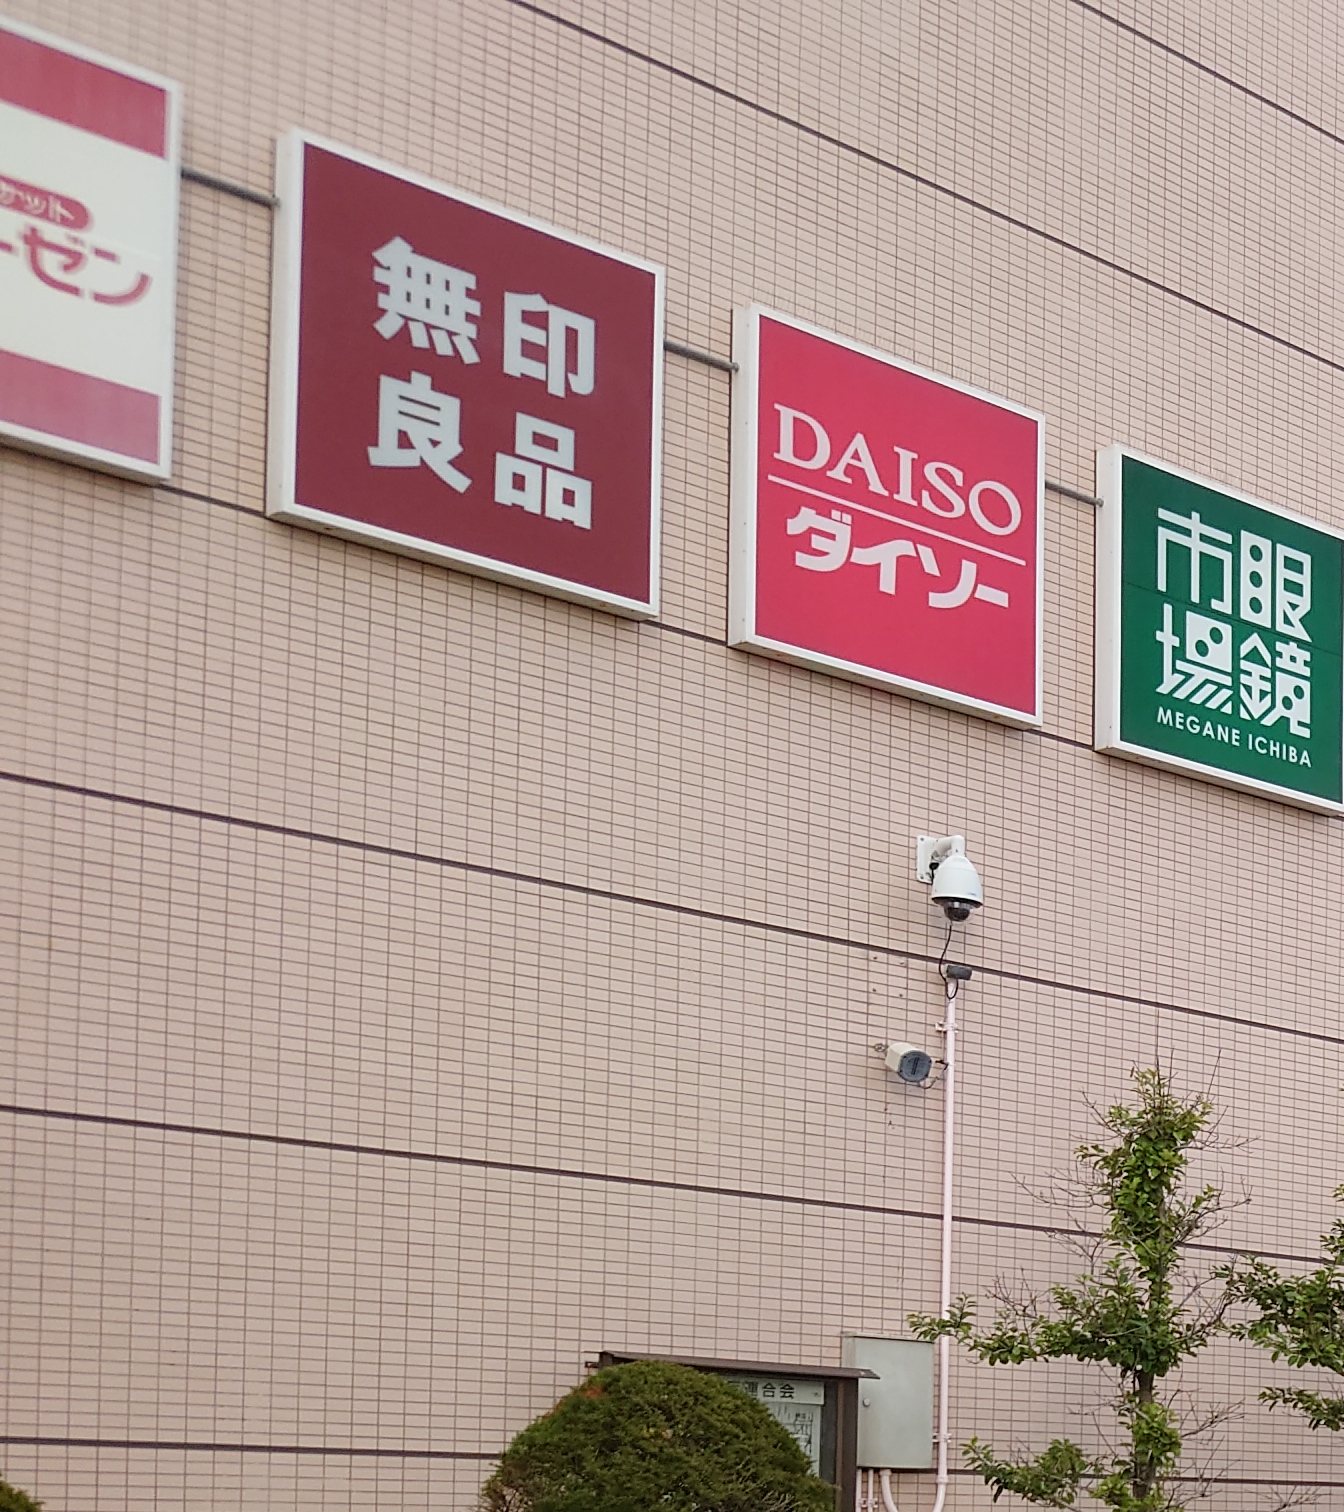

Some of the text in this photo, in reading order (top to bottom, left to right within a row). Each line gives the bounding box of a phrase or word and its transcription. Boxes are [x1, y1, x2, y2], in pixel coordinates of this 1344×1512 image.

[0, 226, 151, 305] ゼン
[372, 235, 596, 398] 無印
[367, 370, 593, 530] 良品
[774, 403, 1022, 536] DAISO
[786, 506, 1009, 609] ダイソー
[1156, 706, 1312, 769] MEGANE ICHIBA
